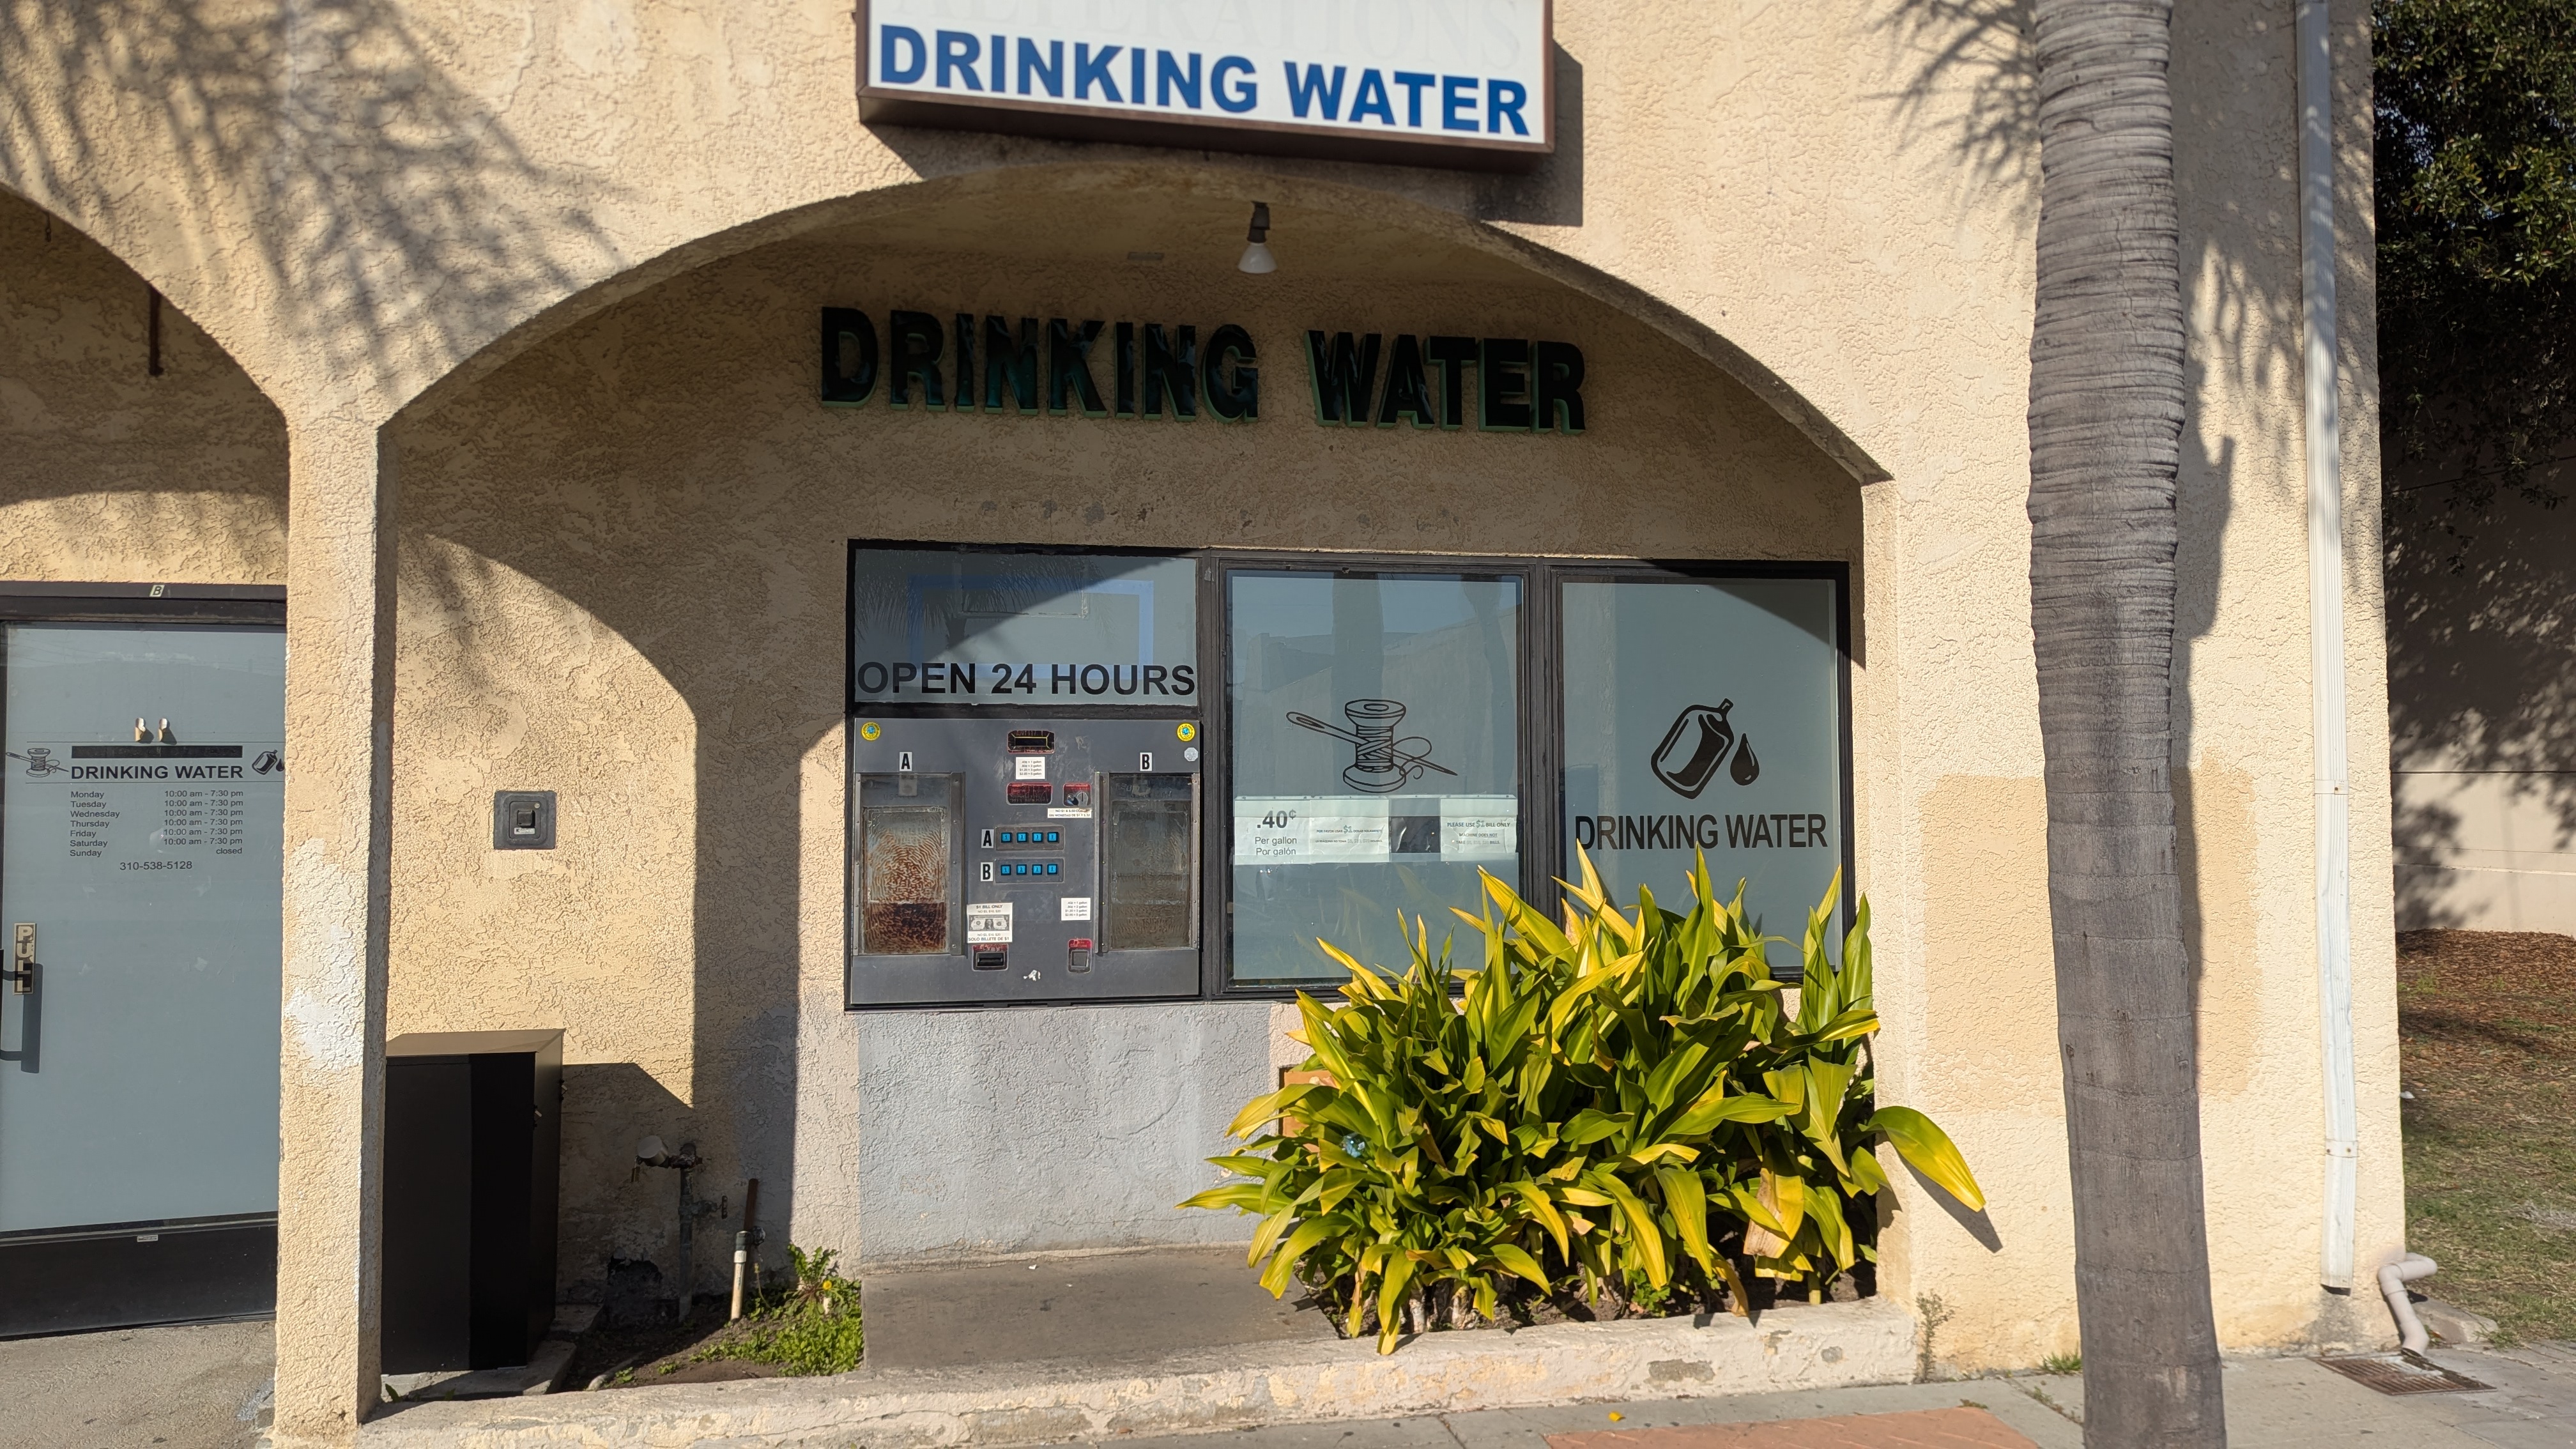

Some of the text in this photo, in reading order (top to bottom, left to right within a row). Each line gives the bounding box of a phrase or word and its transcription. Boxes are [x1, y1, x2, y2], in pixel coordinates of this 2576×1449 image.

[880, 24, 1530, 137] DRINKING WATER
[821, 305, 1588, 436] DRINKING WATER
[153, 585, 162, 595] B
[857, 662, 1195, 696] OPEN 24 HOURS
[901, 753, 910, 769] A
[1142, 755, 1150, 769] B
[72, 766, 243, 779] DRINKING WATER
[71, 791, 104, 799] Monday
[71, 801, 107, 809] Tuesday
[1257, 809, 1296, 828] .40¢
[1476, 820, 1485, 828] $1
[1344, 825, 1353, 834] $1
[1575, 814, 1828, 850] DRINKING WATER
[70, 839, 108, 848] Saturday
[983, 831, 992, 846] A
[1272, 836, 1297, 846] gallon
[1273, 847, 1296, 857] galón
[119, 861, 192, 870] 310-538-5128
[983, 864, 990, 880] B
[17, 926, 33, 992] PULL
